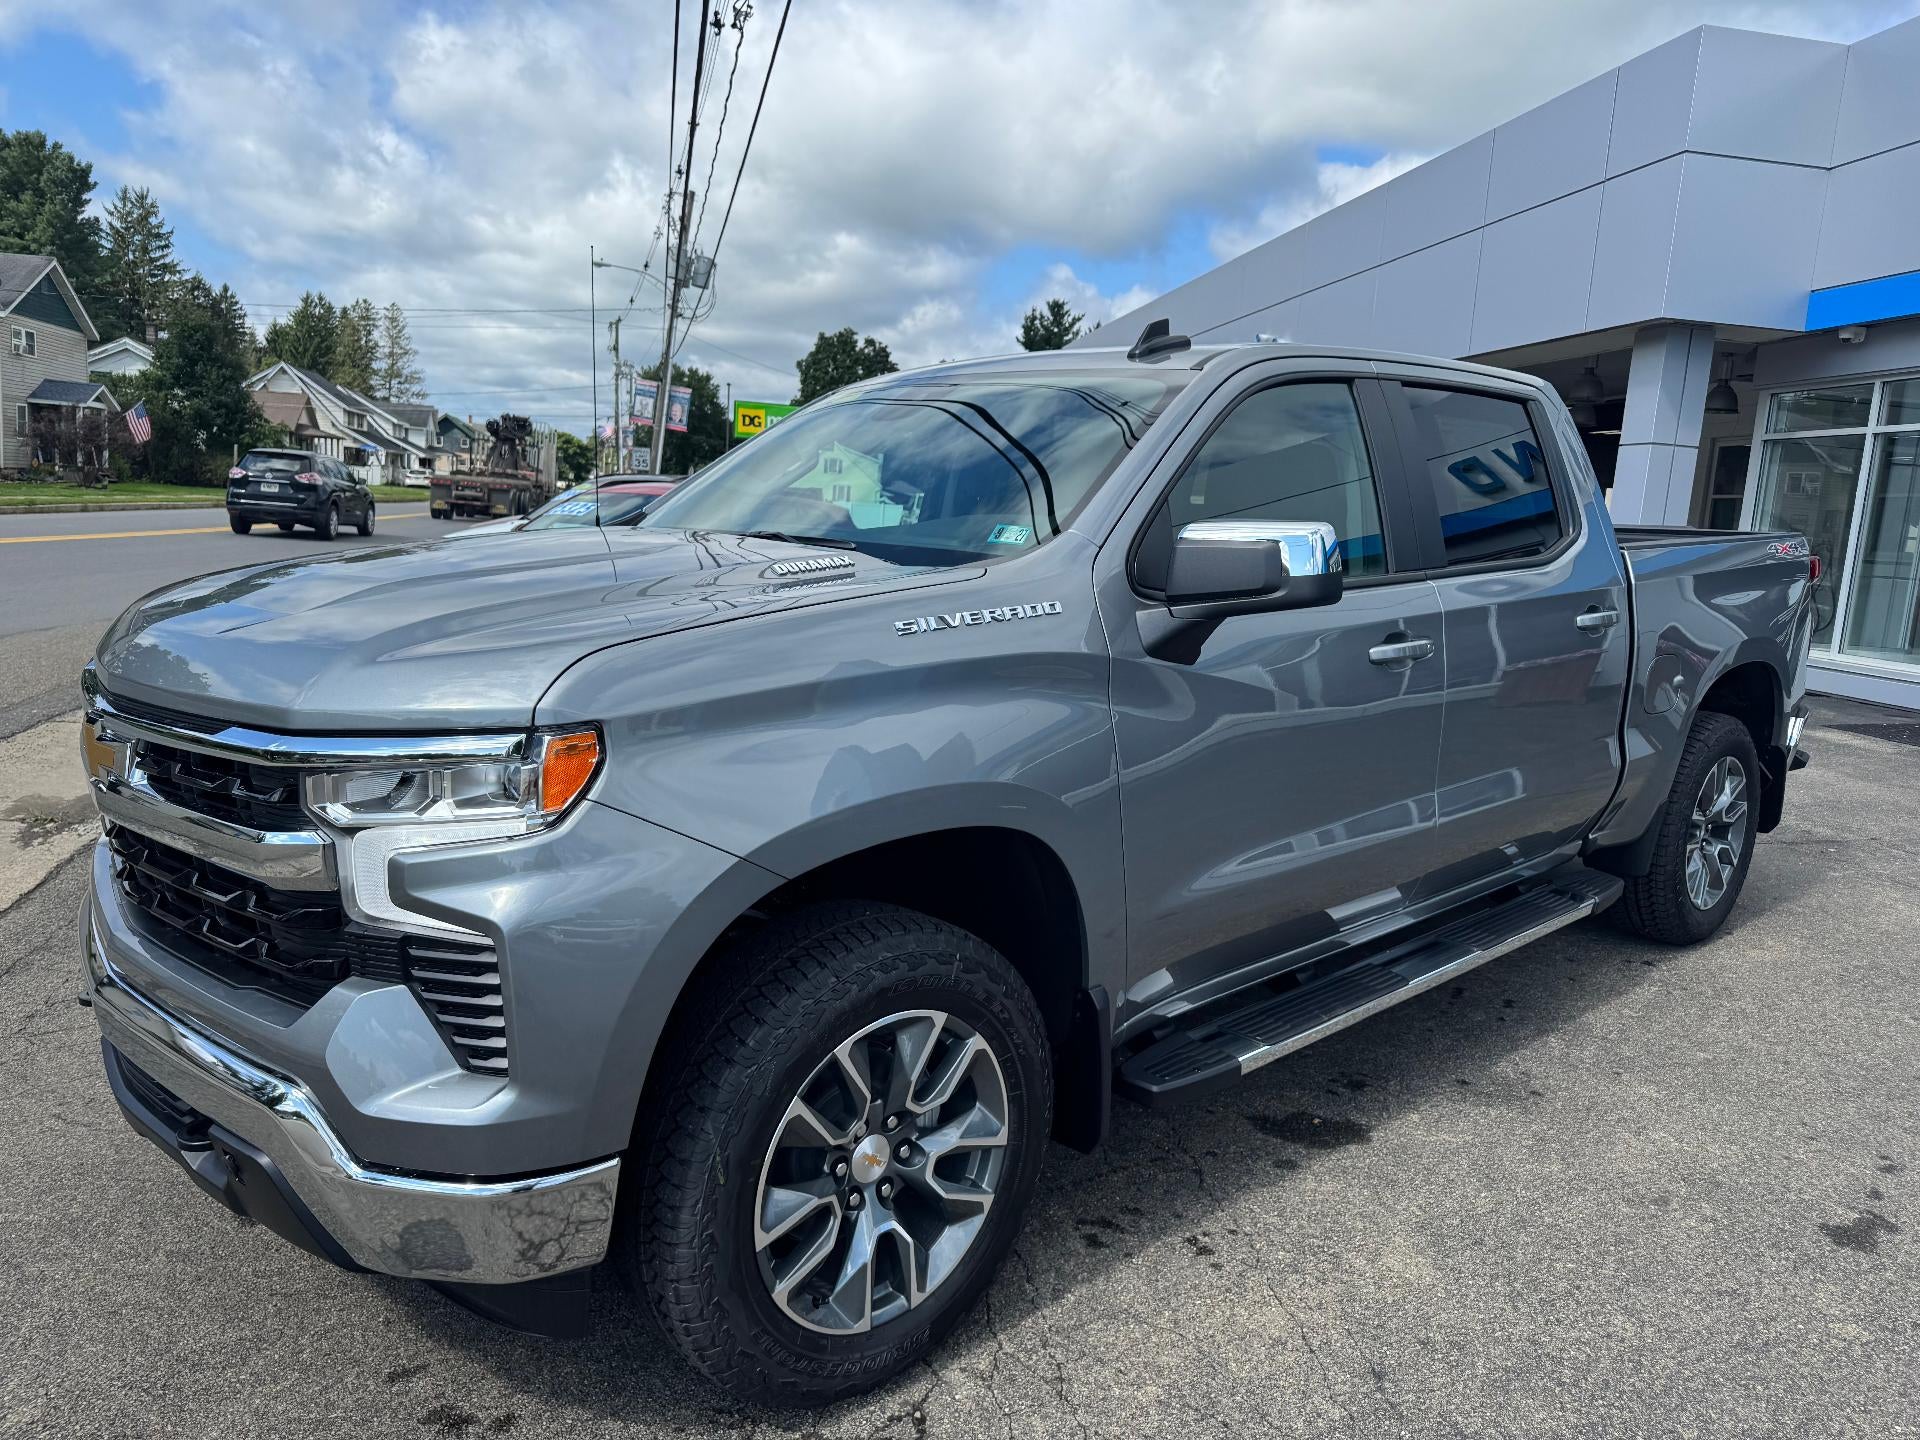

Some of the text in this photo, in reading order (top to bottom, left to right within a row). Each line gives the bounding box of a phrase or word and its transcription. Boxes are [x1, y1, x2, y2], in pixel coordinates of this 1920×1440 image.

[741, 414, 762, 427] DG
[634, 458, 649, 468] 35
[995, 527, 1029, 541] 9 27
[771, 556, 856, 577] DURAMAX
[894, 600, 1063, 636] SILVERADO
[752, 1326, 931, 1377] BRIDGESTONE
